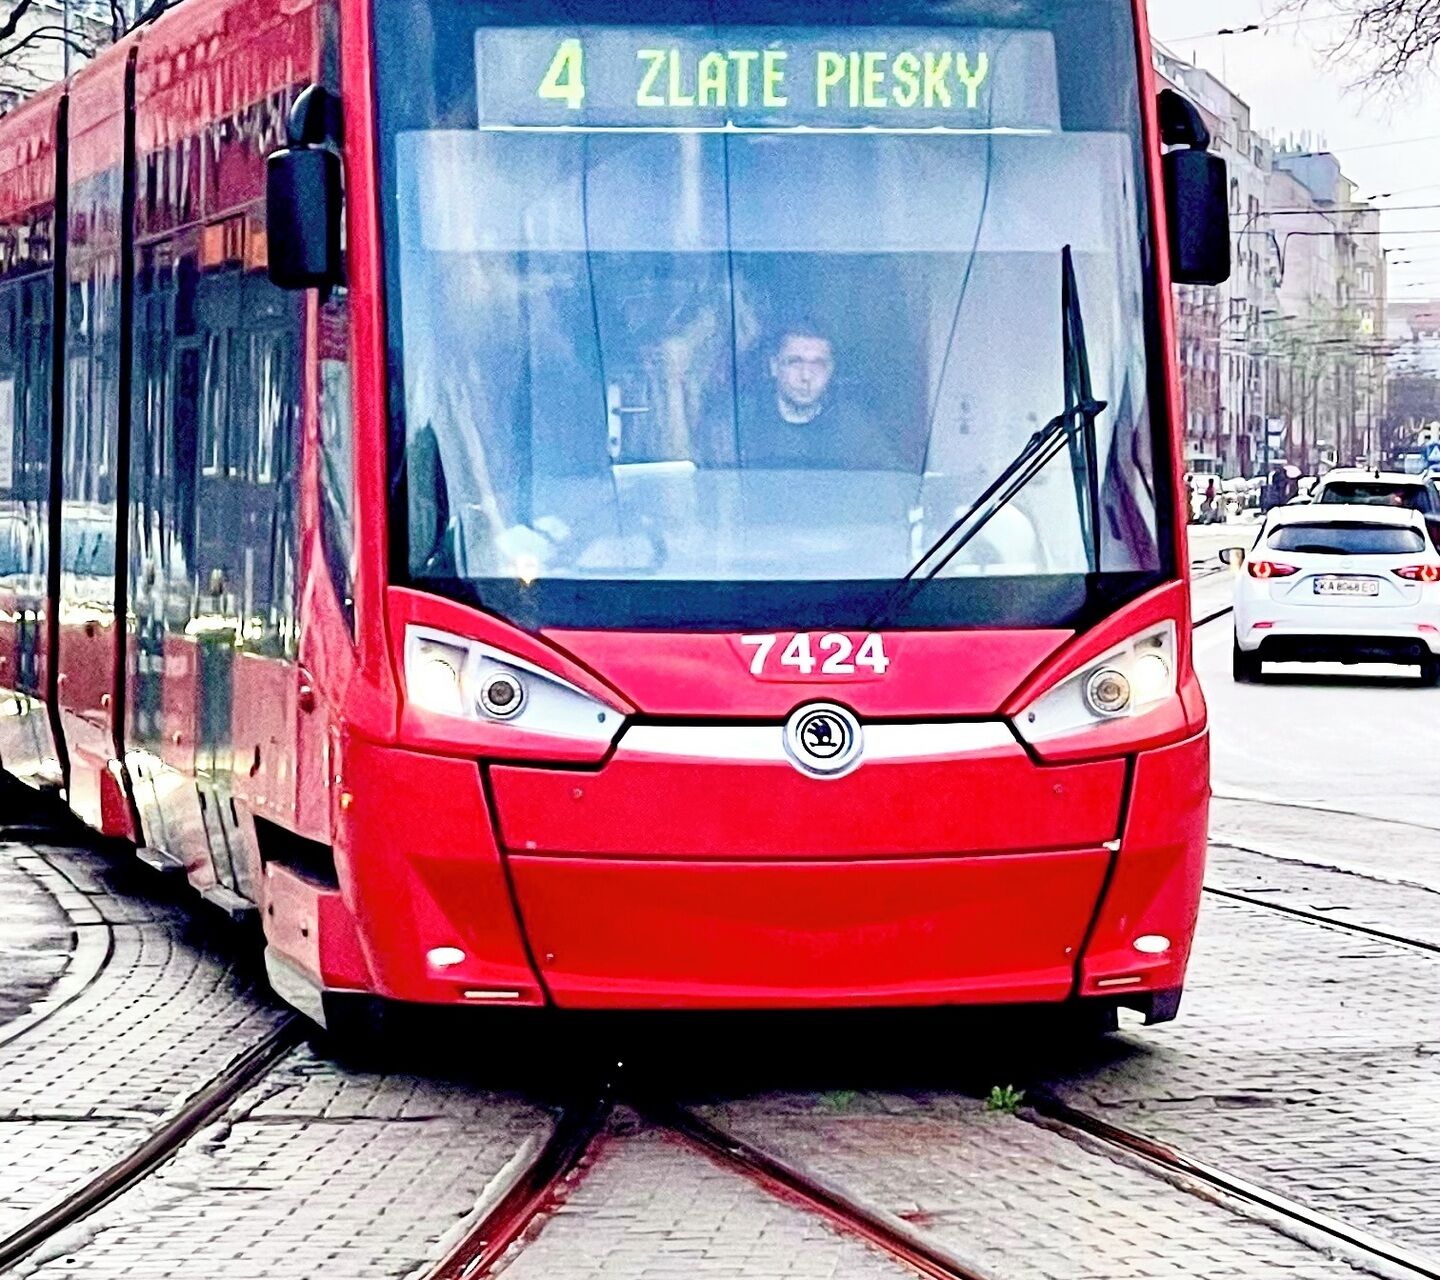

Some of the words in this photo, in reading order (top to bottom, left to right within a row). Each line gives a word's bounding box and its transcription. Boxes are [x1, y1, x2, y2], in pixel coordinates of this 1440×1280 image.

[538, 39, 586, 109] 4
[817, 50, 989, 108] PIESKY
[739, 632, 890, 675] 7424
